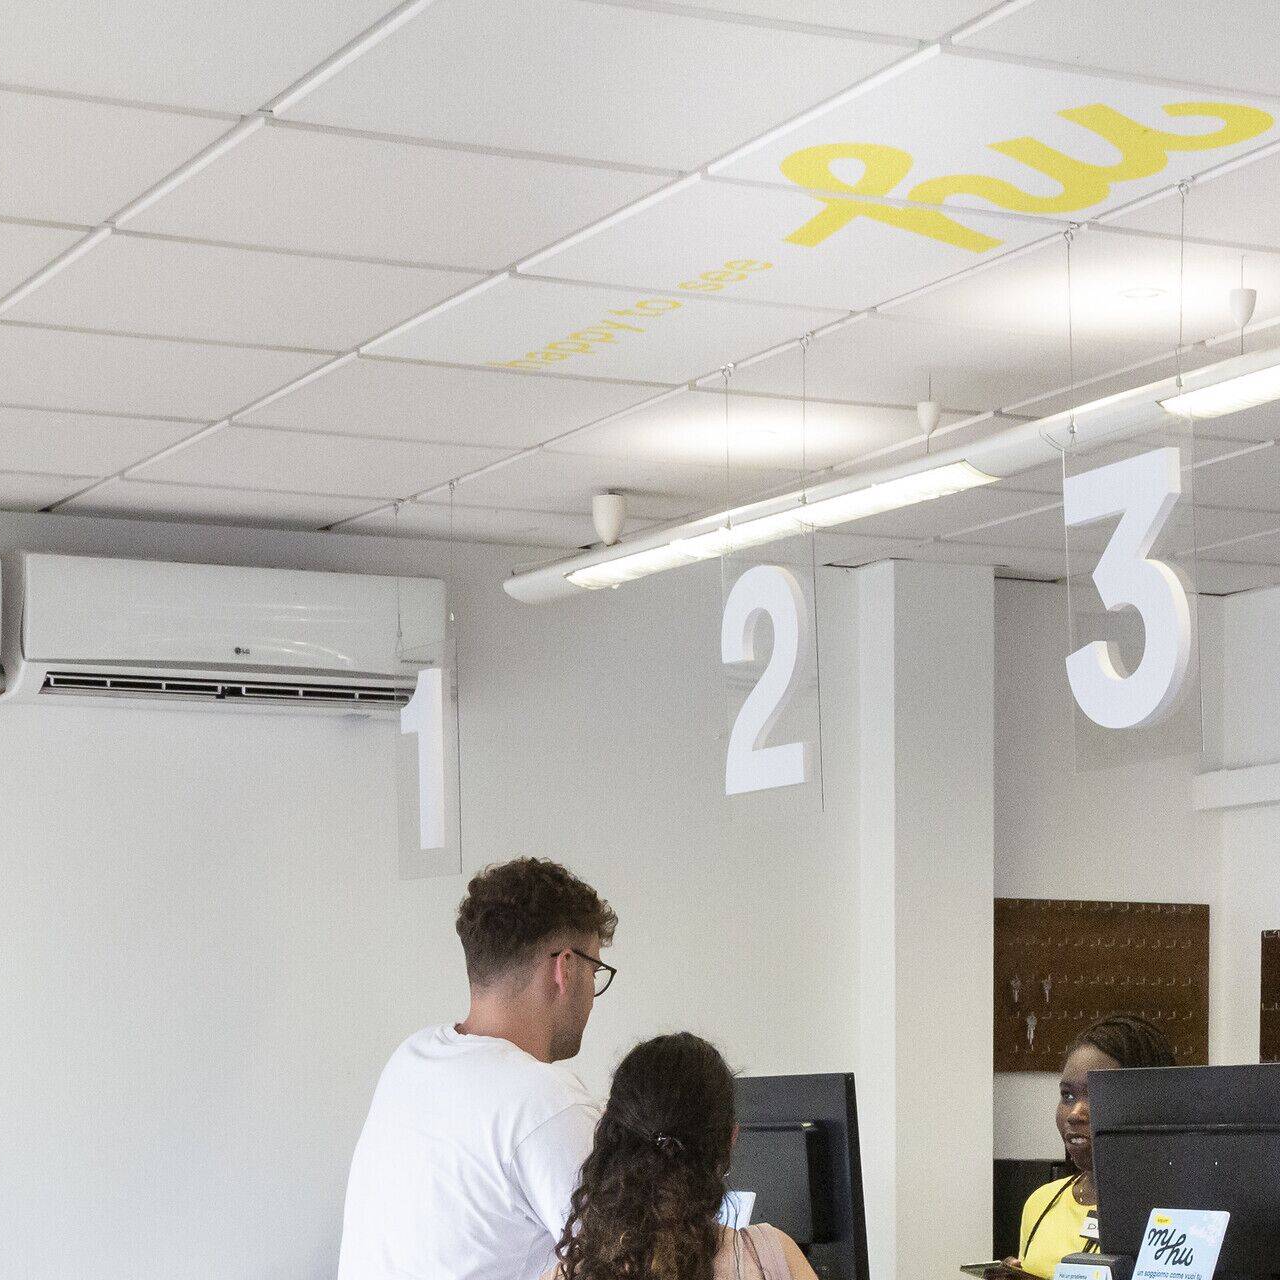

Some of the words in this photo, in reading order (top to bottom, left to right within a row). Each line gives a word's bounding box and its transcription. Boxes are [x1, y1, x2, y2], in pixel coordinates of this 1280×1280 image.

[486, 320, 646, 369] happy
[608, 299, 683, 317] to
[678, 259, 774, 292] see
[721, 564, 806, 795] 2
[1064, 446, 1191, 730] 3
[400, 666, 445, 849] 1
